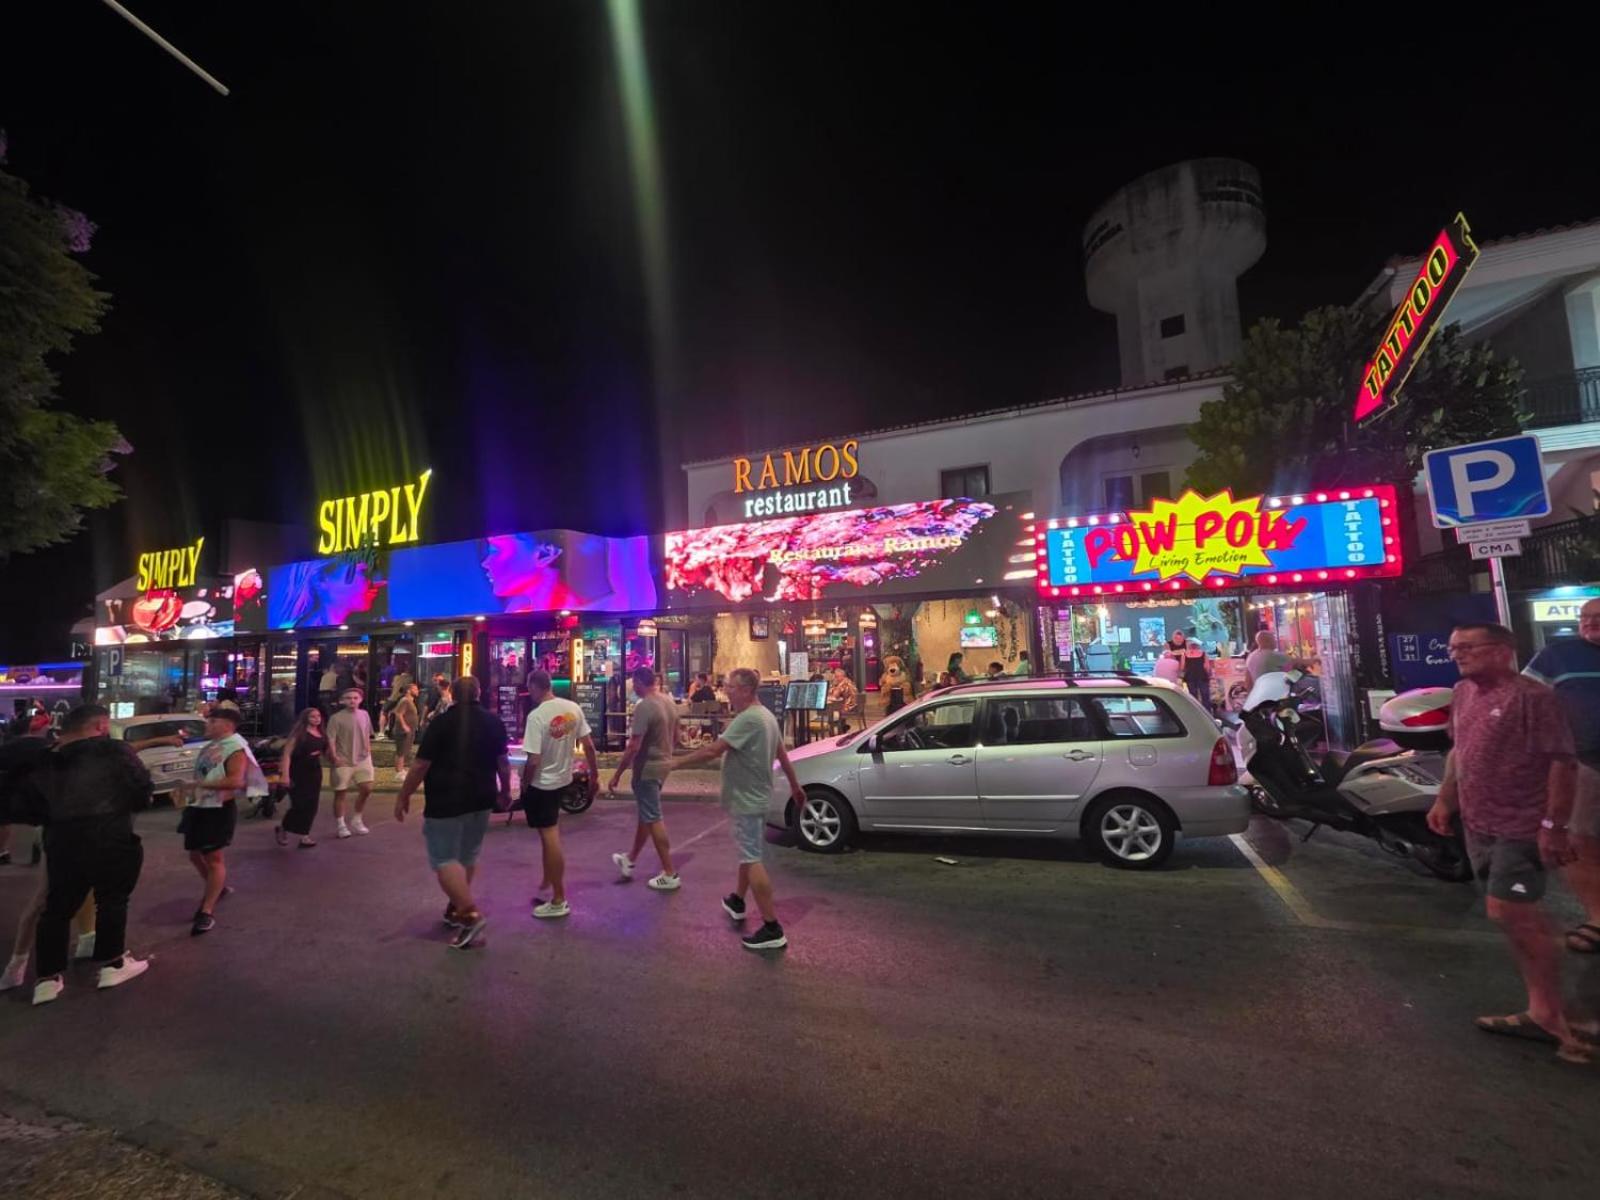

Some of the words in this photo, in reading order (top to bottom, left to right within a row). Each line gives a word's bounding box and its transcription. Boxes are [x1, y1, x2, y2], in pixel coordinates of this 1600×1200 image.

[1364, 243, 1449, 399] TATTOO
[734, 440, 859, 493] RAMOS
[1449, 449, 1516, 517] P
[319, 468, 432, 554] SIMPLY
[745, 482, 852, 517] restaurant
[883, 535, 962, 553] Ramos
[1060, 529, 1077, 583] TATTOO
[1083, 511, 1178, 568] POW
[1195, 511, 1308, 552] POW
[1342, 500, 1367, 562] TATTOO
[1478, 543, 1514, 555] CMA
[136, 536, 205, 592] SIMPLY
[1149, 556, 1190, 569] Living
[1194, 551, 1247, 566] Emotion
[109, 650, 121, 675] P
